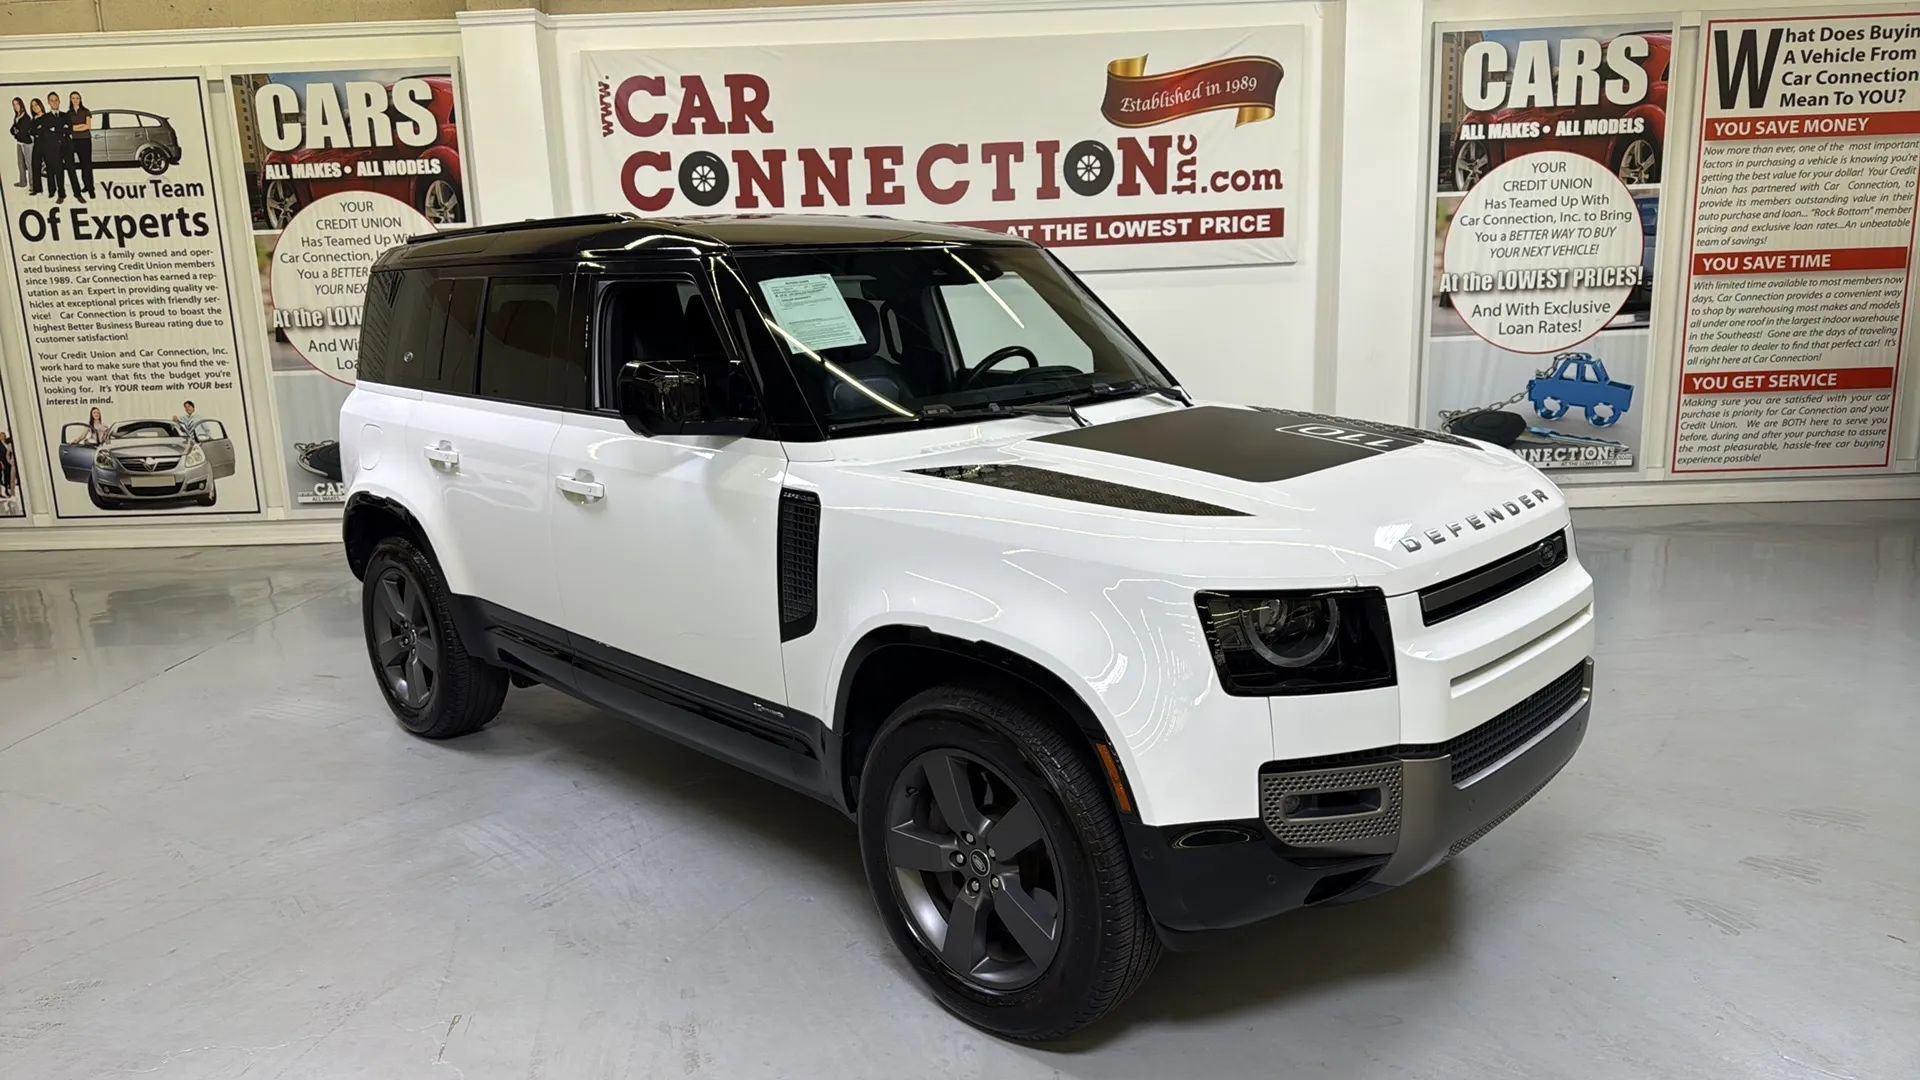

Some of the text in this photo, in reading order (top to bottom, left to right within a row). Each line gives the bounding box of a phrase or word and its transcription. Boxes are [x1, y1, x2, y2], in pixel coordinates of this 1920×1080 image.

[1820, 27, 1865, 42] Does
[1870, 24, 1920, 43] Buyin
[1783, 47, 1916, 64] A Vehicle From
[1462, 35, 1649, 111] CARS
[1781, 68, 1919, 86] Car Connection
[1120, 76, 1257, 112] Established in 1989
[1779, 89, 1906, 108] Mean To YOU?
[615, 74, 774, 137] CAR
[254, 79, 438, 151] CARS
[1460, 117, 1645, 141] ALL MAKES ALL MODELS
[1714, 118, 1869, 136] YOU SAVE MONEY
[265, 158, 442, 180] ALL MAKES ALL MODELS
[621, 135, 1172, 212] CONNECTION
[1201, 168, 1283, 193] .com
[1531, 162, 1567, 173] YOUR
[101, 180, 204, 199] Your Team
[1503, 178, 1592, 192] CREDIT UNION
[1700, 186, 1727, 195] Union
[1750, 184, 1796, 195] partnered
[1800, 183, 1819, 191] with
[1847, 181, 1900, 189] Connection,
[340, 201, 374, 212] YOUR
[1485, 194, 1609, 209] Has Teamed Up With
[316, 217, 401, 230] CREDIT UNION
[1460, 209, 1632, 226] Car Connection, Inc. to Bring
[19, 207, 210, 248] Of Experts
[1007, 215, 1271, 241] AT THE LOWEST PRICE
[1475, 226, 1616, 242] You a BETTER WAY TO BUY
[302, 236, 322, 248] Has
[326, 235, 370, 246] Teamed
[374, 234, 391, 248] Up
[1731, 236, 1767, 246] savings!
[280, 253, 299, 263] Car
[302, 250, 373, 263] Connection,
[1490, 244, 1599, 258] YOUR NEXT VEHICLE!
[1703, 254, 1831, 271] YOU SAVE TIME
[298, 267, 368, 280] You a BETTER
[1439, 266, 1644, 293] At the LOWEST PRICES!
[315, 284, 344, 295] YOUR
[1472, 300, 1611, 318] And With Exclusive
[32, 323, 65, 333] highest
[134, 320, 165, 328] Bureau
[167, 319, 193, 328] rating
[273, 308, 290, 329] At
[294, 307, 323, 328] the
[1498, 320, 1582, 335] Loan Rates!
[76, 333, 128, 341] satisfaction!
[308, 338, 360, 352] And Wi
[60, 351, 87, 359] Credit
[89, 350, 116, 358] Union
[156, 348, 208, 356] Connection,
[1699, 356, 1720, 366] right
[1721, 356, 1740, 364] here
[1769, 353, 1822, 362] Connection!
[43, 386, 76, 394] looking
[187, 381, 211, 389] YOUR
[1692, 373, 1838, 390] YOU GET SERVICE
[1680, 421, 1706, 430] Credit
[1709, 421, 1737, 429] Union.
[1781, 418, 1806, 426] BOTH
[1677, 453, 1761, 465] experience possible!
[1398, 488, 1549, 552] DEFENDER
